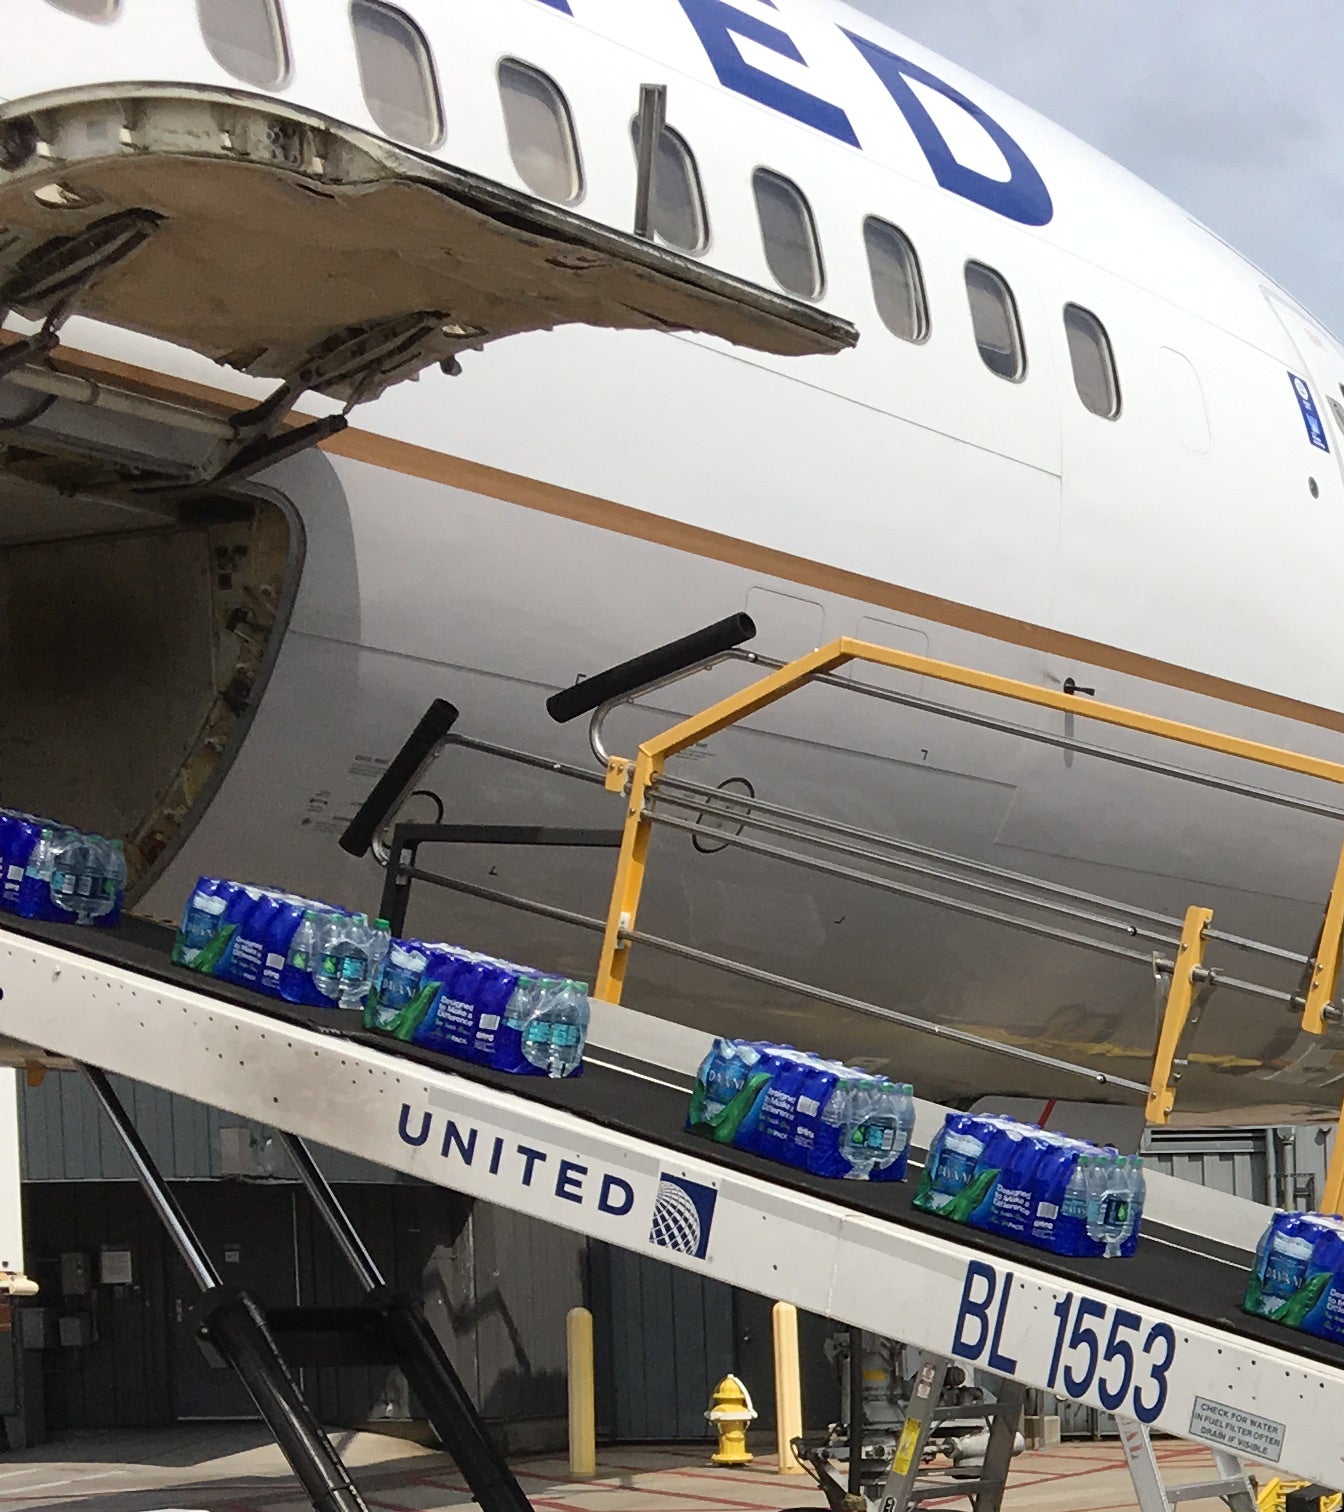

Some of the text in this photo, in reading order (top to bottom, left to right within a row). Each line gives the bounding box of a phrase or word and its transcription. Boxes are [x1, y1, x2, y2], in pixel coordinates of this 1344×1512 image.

[540, 0, 1054, 226] ED
[398, 1103, 635, 1217] UNITED
[951, 1259, 1176, 1424] BL 1553
[1201, 1403, 1279, 1434] CHECK FOR WATER
[1201, 1426, 1226, 1440] DRAIN
[1237, 1438, 1269, 1455] VISIBLE
[1204, 1415, 1224, 1429] FUEL
[1225, 1421, 1253, 1438] FILTER
[1253, 1432, 1280, 1447] OFTEN
